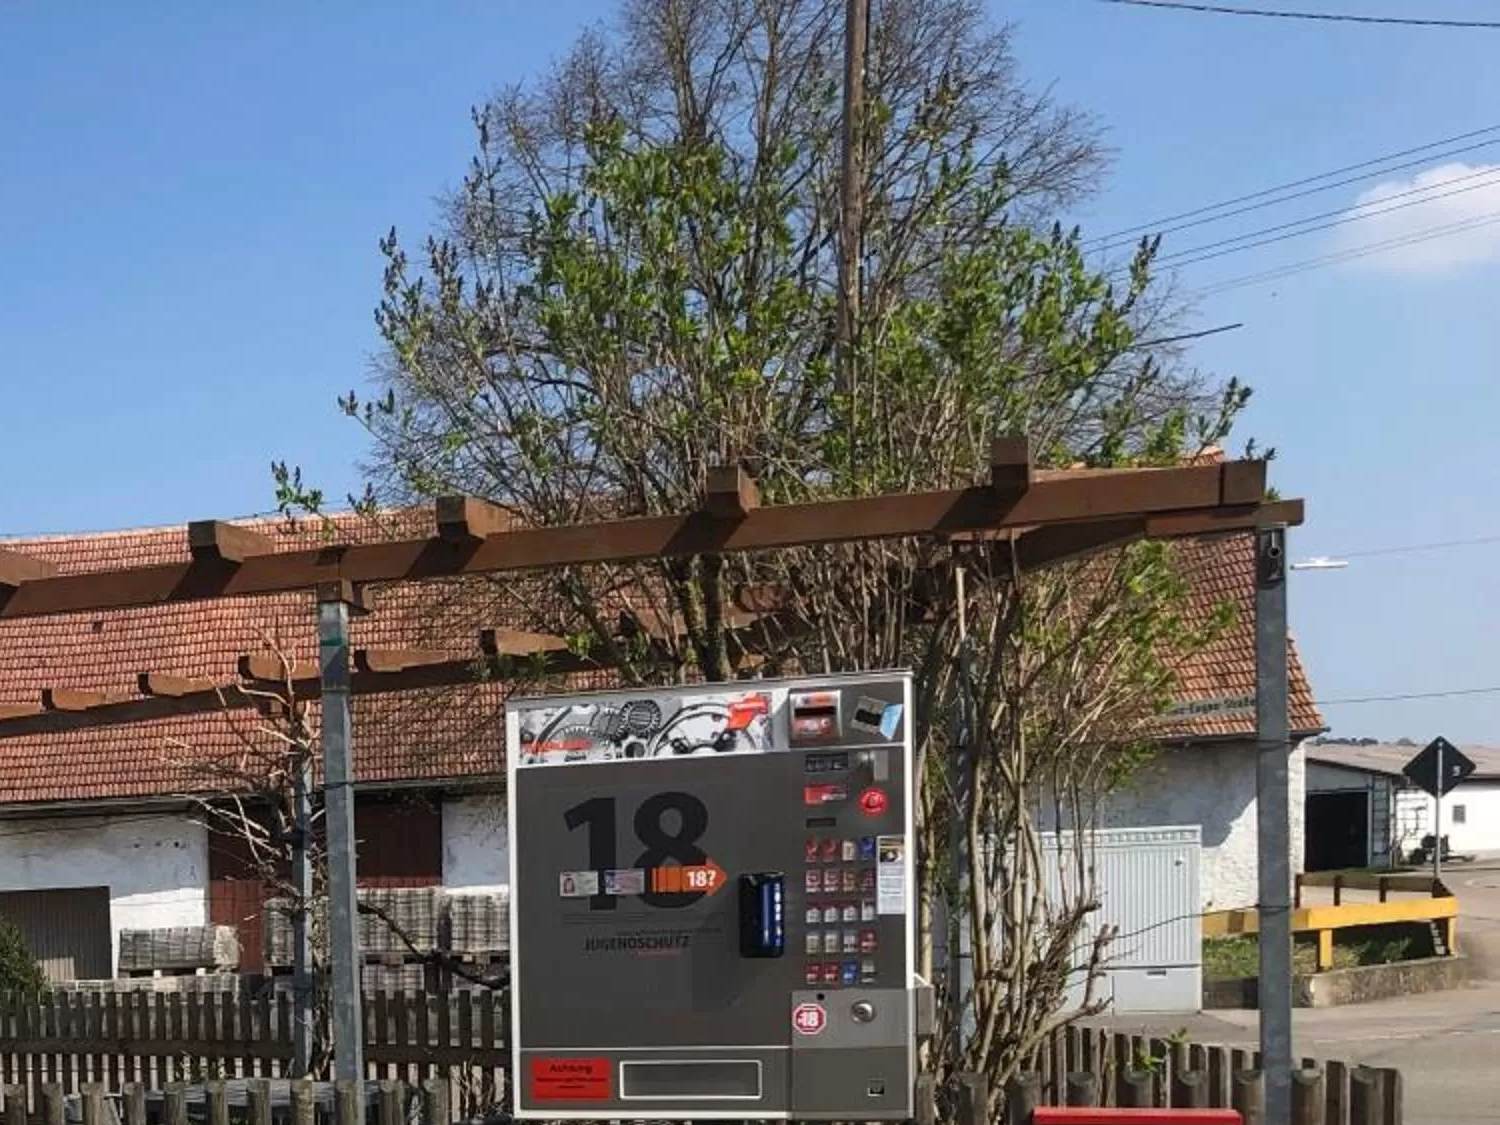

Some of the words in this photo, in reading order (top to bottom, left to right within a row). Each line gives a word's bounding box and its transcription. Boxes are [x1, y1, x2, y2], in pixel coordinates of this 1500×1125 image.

[563, 791, 709, 911] 18
[686, 869, 717, 888] 18?
[585, 935, 691, 953] JUGENDSCHUTZ
